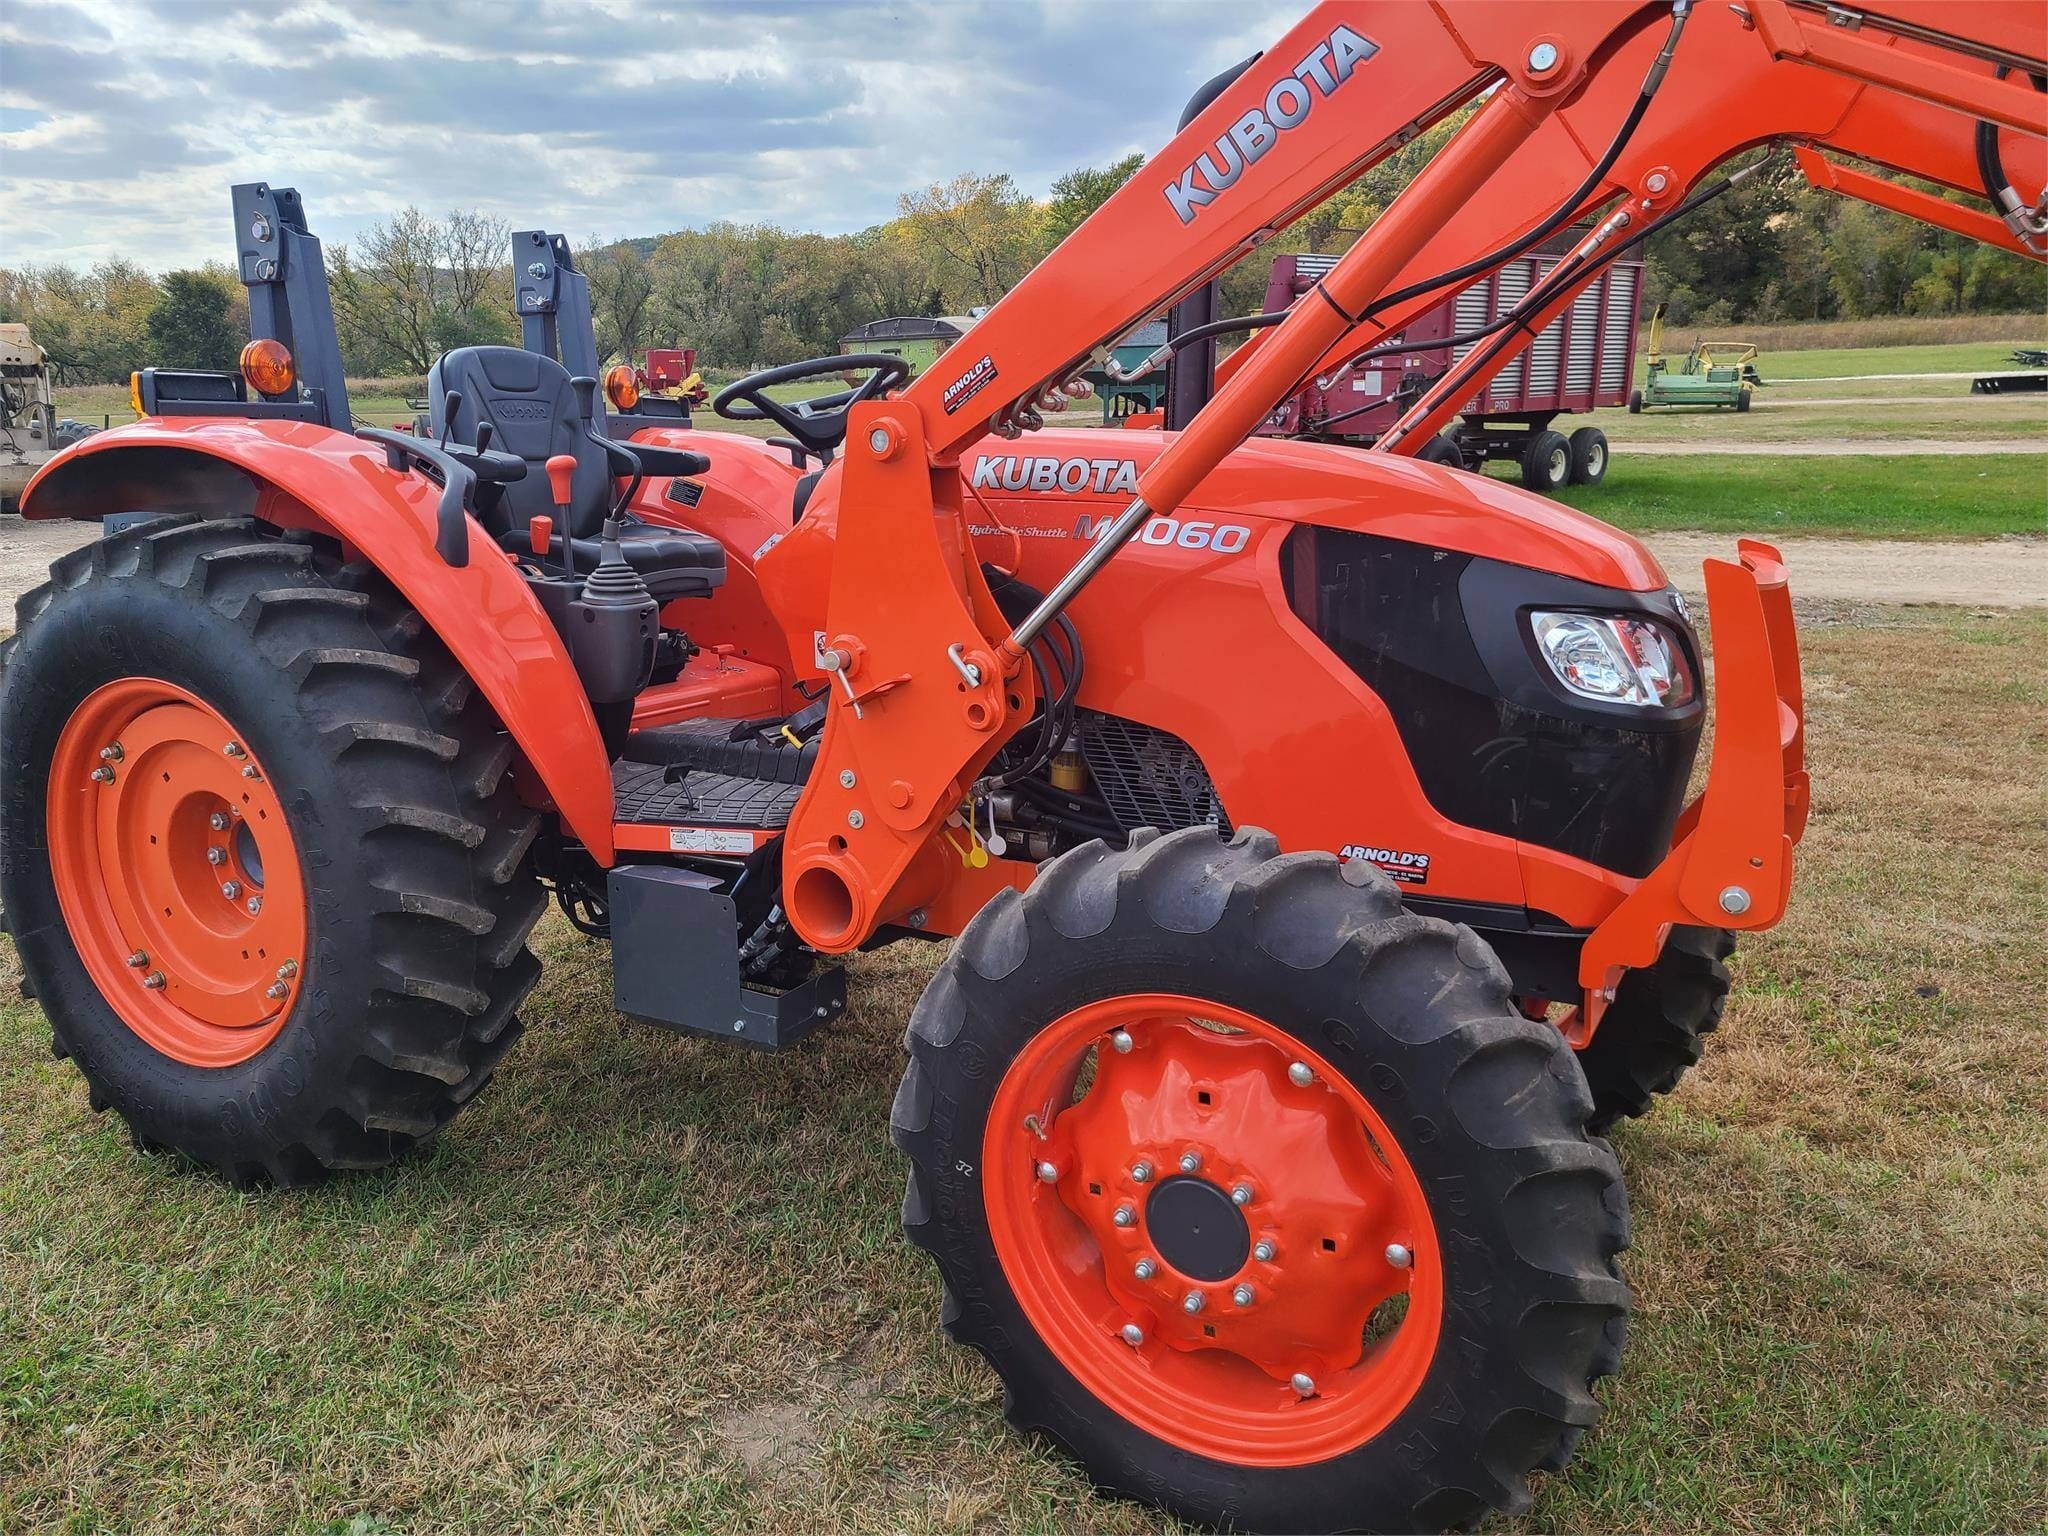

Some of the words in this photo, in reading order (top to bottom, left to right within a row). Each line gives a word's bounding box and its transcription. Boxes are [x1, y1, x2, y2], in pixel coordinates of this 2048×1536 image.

[1163, 24, 1380, 225] KUBOTA
[944, 355, 992, 403] ARNOLD'S
[496, 402, 548, 419] Kubota
[1494, 400, 1510, 411] PRO
[973, 455, 1138, 494] KUBOTA
[1024, 527, 1068, 538] Shuttle
[1072, 514, 1251, 554] M060
[1340, 845, 1430, 867] ARNOLD'S
